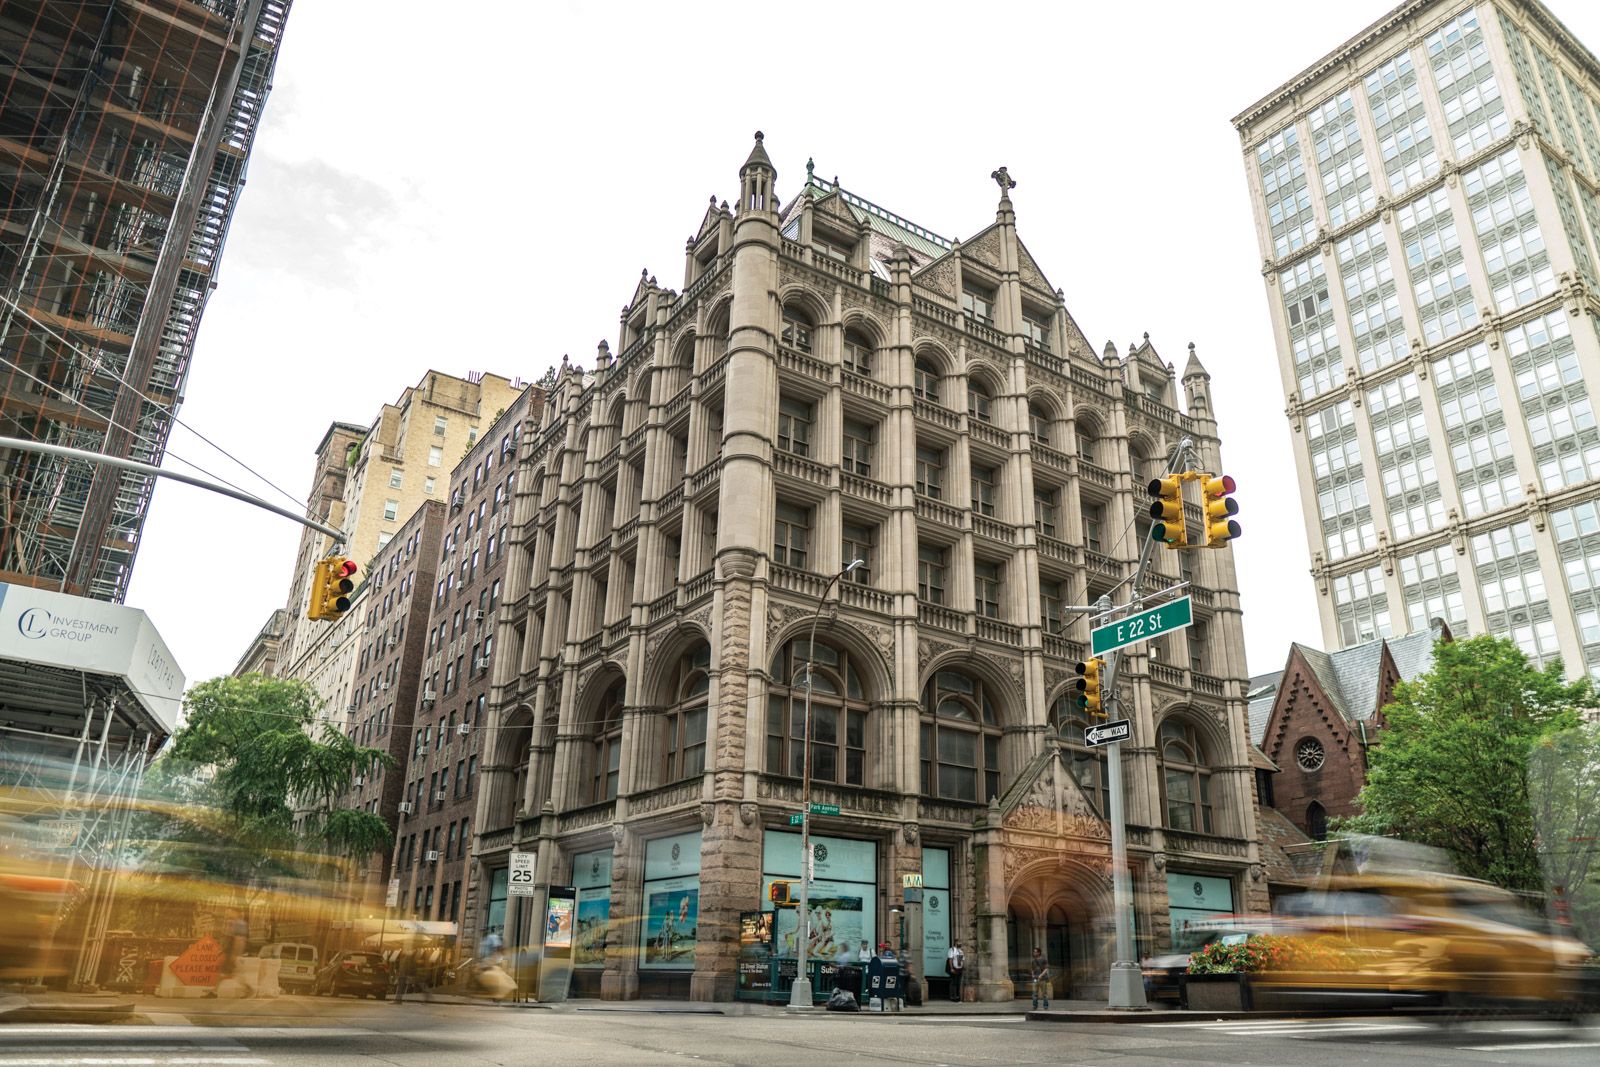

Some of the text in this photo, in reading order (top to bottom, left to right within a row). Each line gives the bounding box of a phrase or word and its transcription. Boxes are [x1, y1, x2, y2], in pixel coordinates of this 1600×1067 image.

[53, 615, 119, 635] INVESTMENT
[1117, 613, 1162, 642] E 22 St
[50, 628, 92, 642] GROUP
[1091, 726, 1126, 740] ONE WAY
[512, 870, 532, 882] 25
[191, 954, 218, 962] CLOSED
[176, 964, 203, 972] PLEASE
[191, 975, 210, 983] RIGHT
